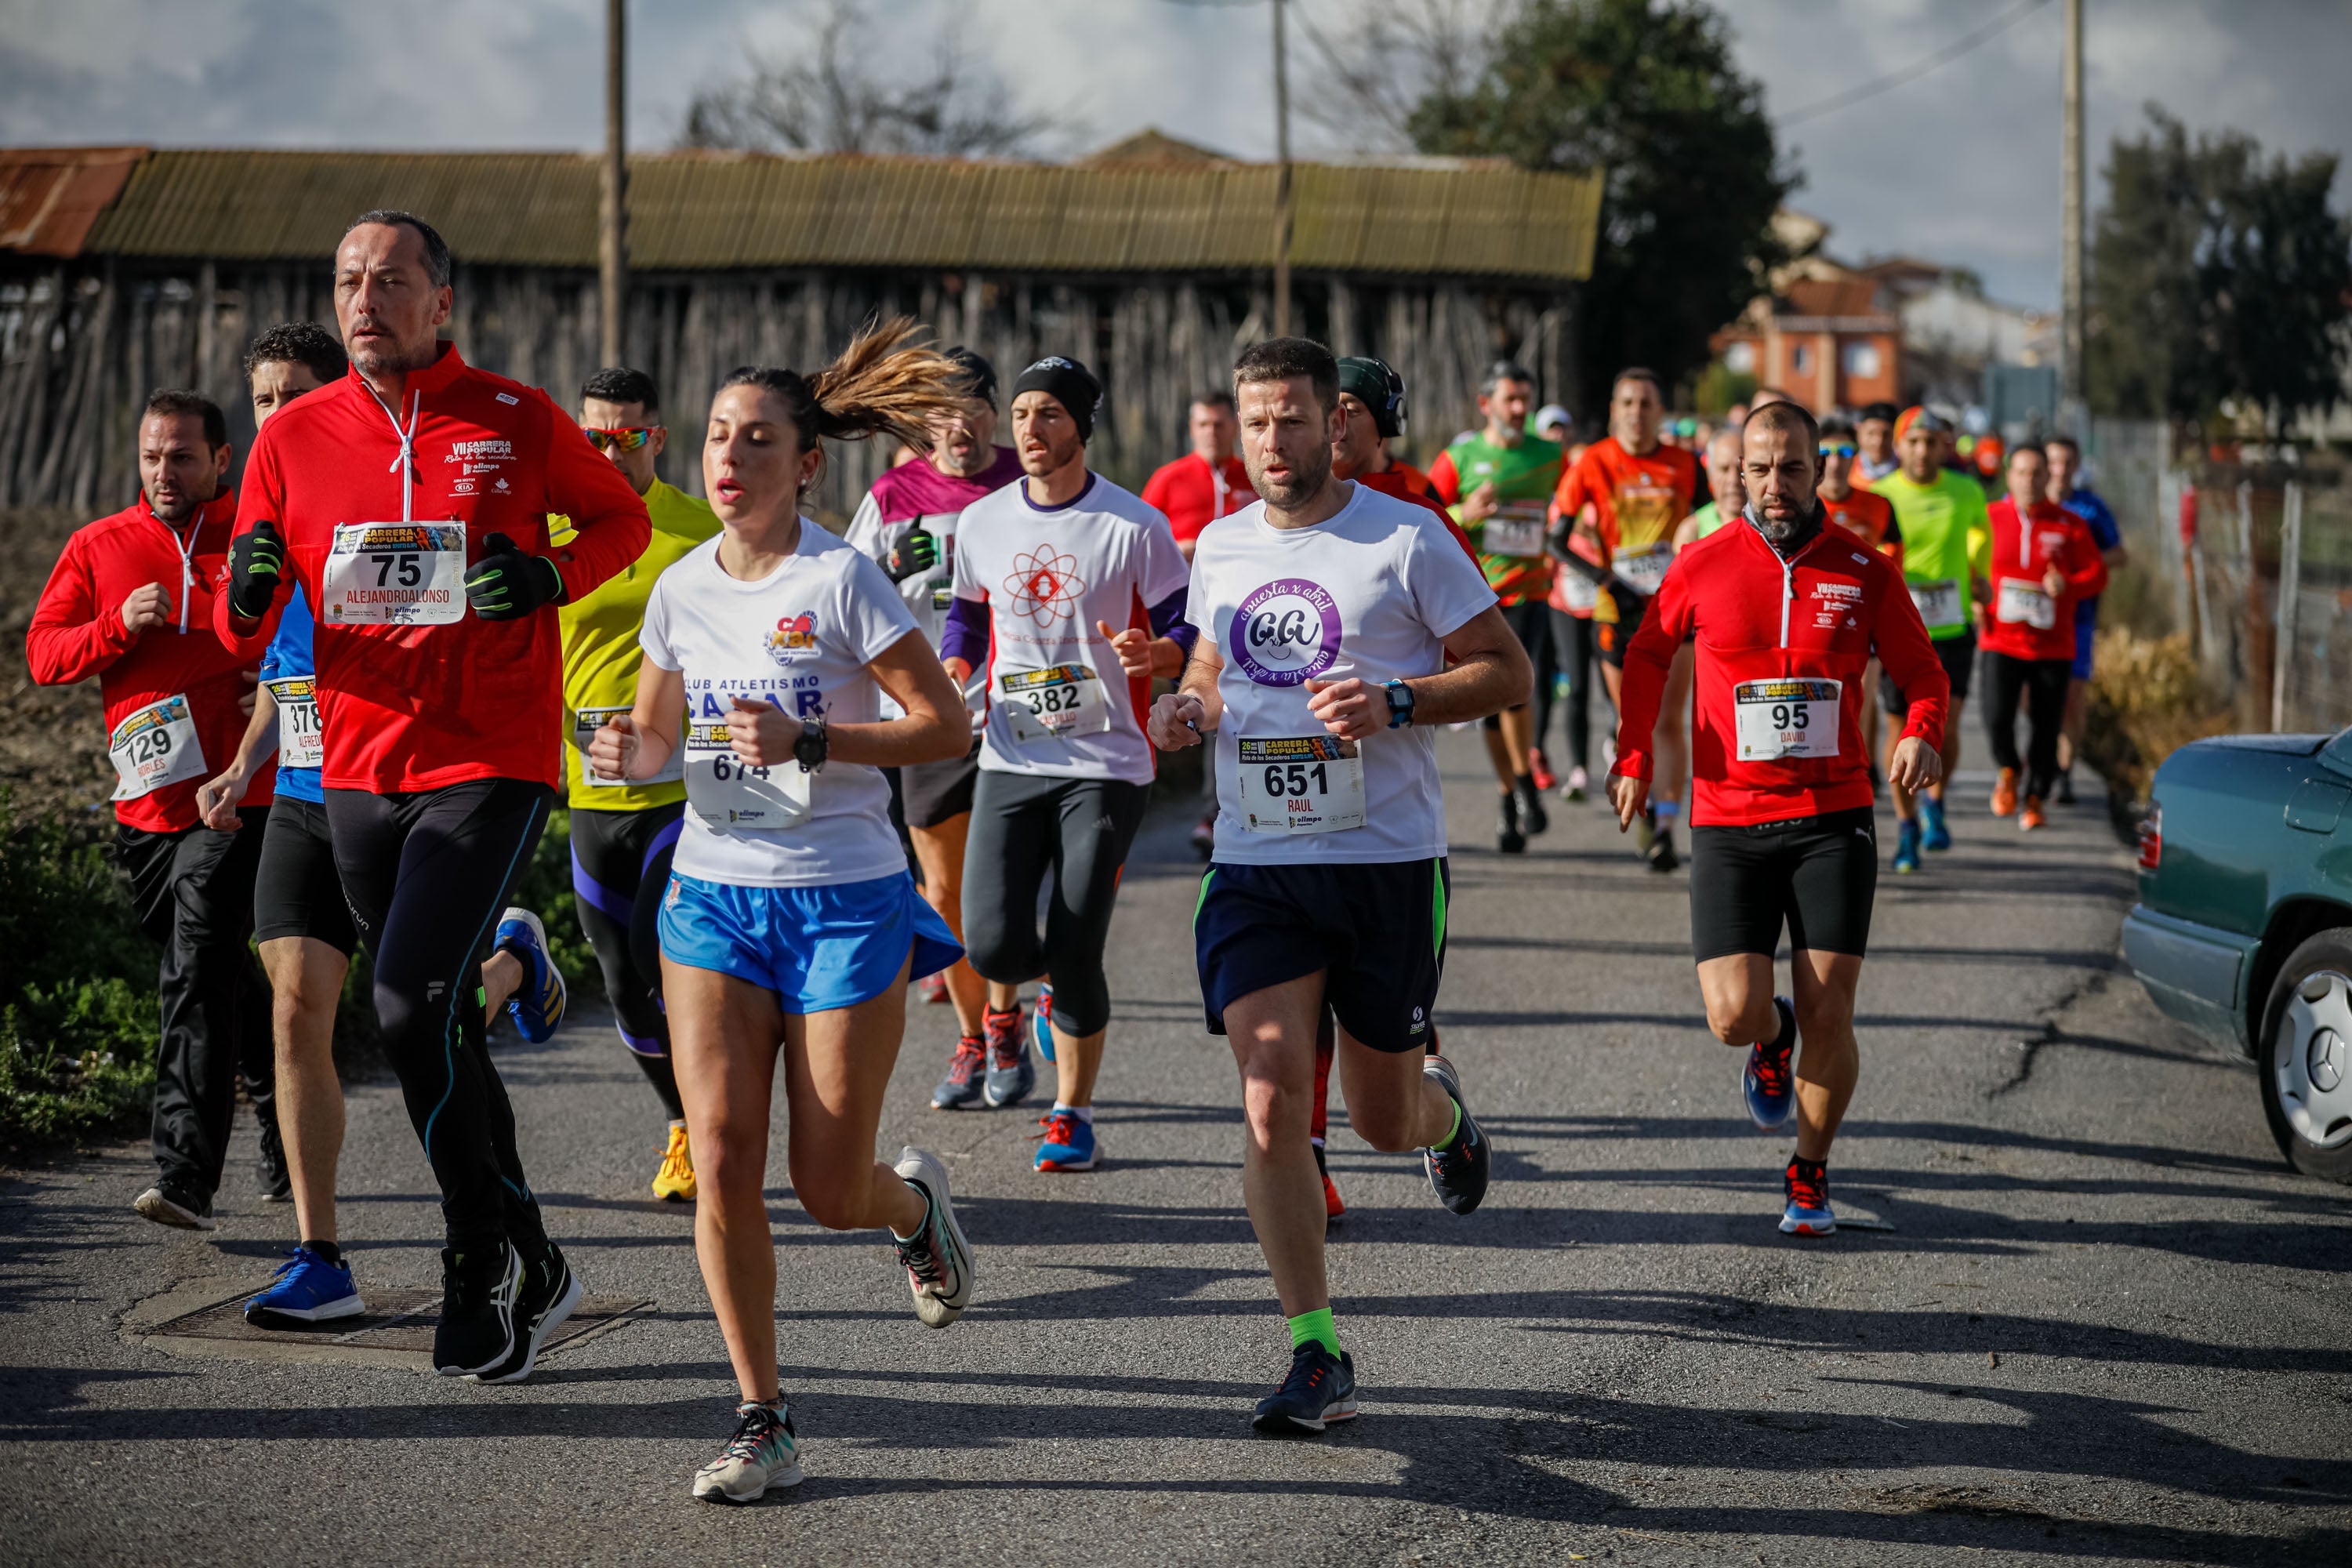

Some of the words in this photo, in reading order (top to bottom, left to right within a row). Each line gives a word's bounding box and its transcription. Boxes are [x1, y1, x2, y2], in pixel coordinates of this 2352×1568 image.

[452, 441, 466, 456] VII
[464, 452, 474, 461] de
[365, 528, 414, 537] CARRERA
[371, 554, 422, 587] 75
[347, 589, 450, 604] ALEJANDROALONSO
[1240, 582, 1289, 621] apuesta
[1291, 584, 1301, 594] x
[1302, 586, 1333, 612] abril
[394, 606, 421, 615] olimpo
[1242, 657, 1269, 680] abril
[1280, 650, 1330, 684] apuesta
[719, 675, 819, 690] ATLETISMO
[1269, 672, 1278, 681] x
[1028, 684, 1081, 715] 382
[290, 702, 324, 734] 378
[1772, 702, 1809, 731] 95
[1265, 739, 1310, 749] CARRERA
[1780, 731, 1806, 742] DAVID
[125, 728, 172, 768] 129
[1242, 741, 1251, 750] 26
[1257, 741, 1266, 754] VII
[713, 753, 771, 781] 674
[1264, 762, 1329, 797] 651
[1287, 798, 1314, 813] RAUL
[1297, 815, 1323, 824] olimpo
